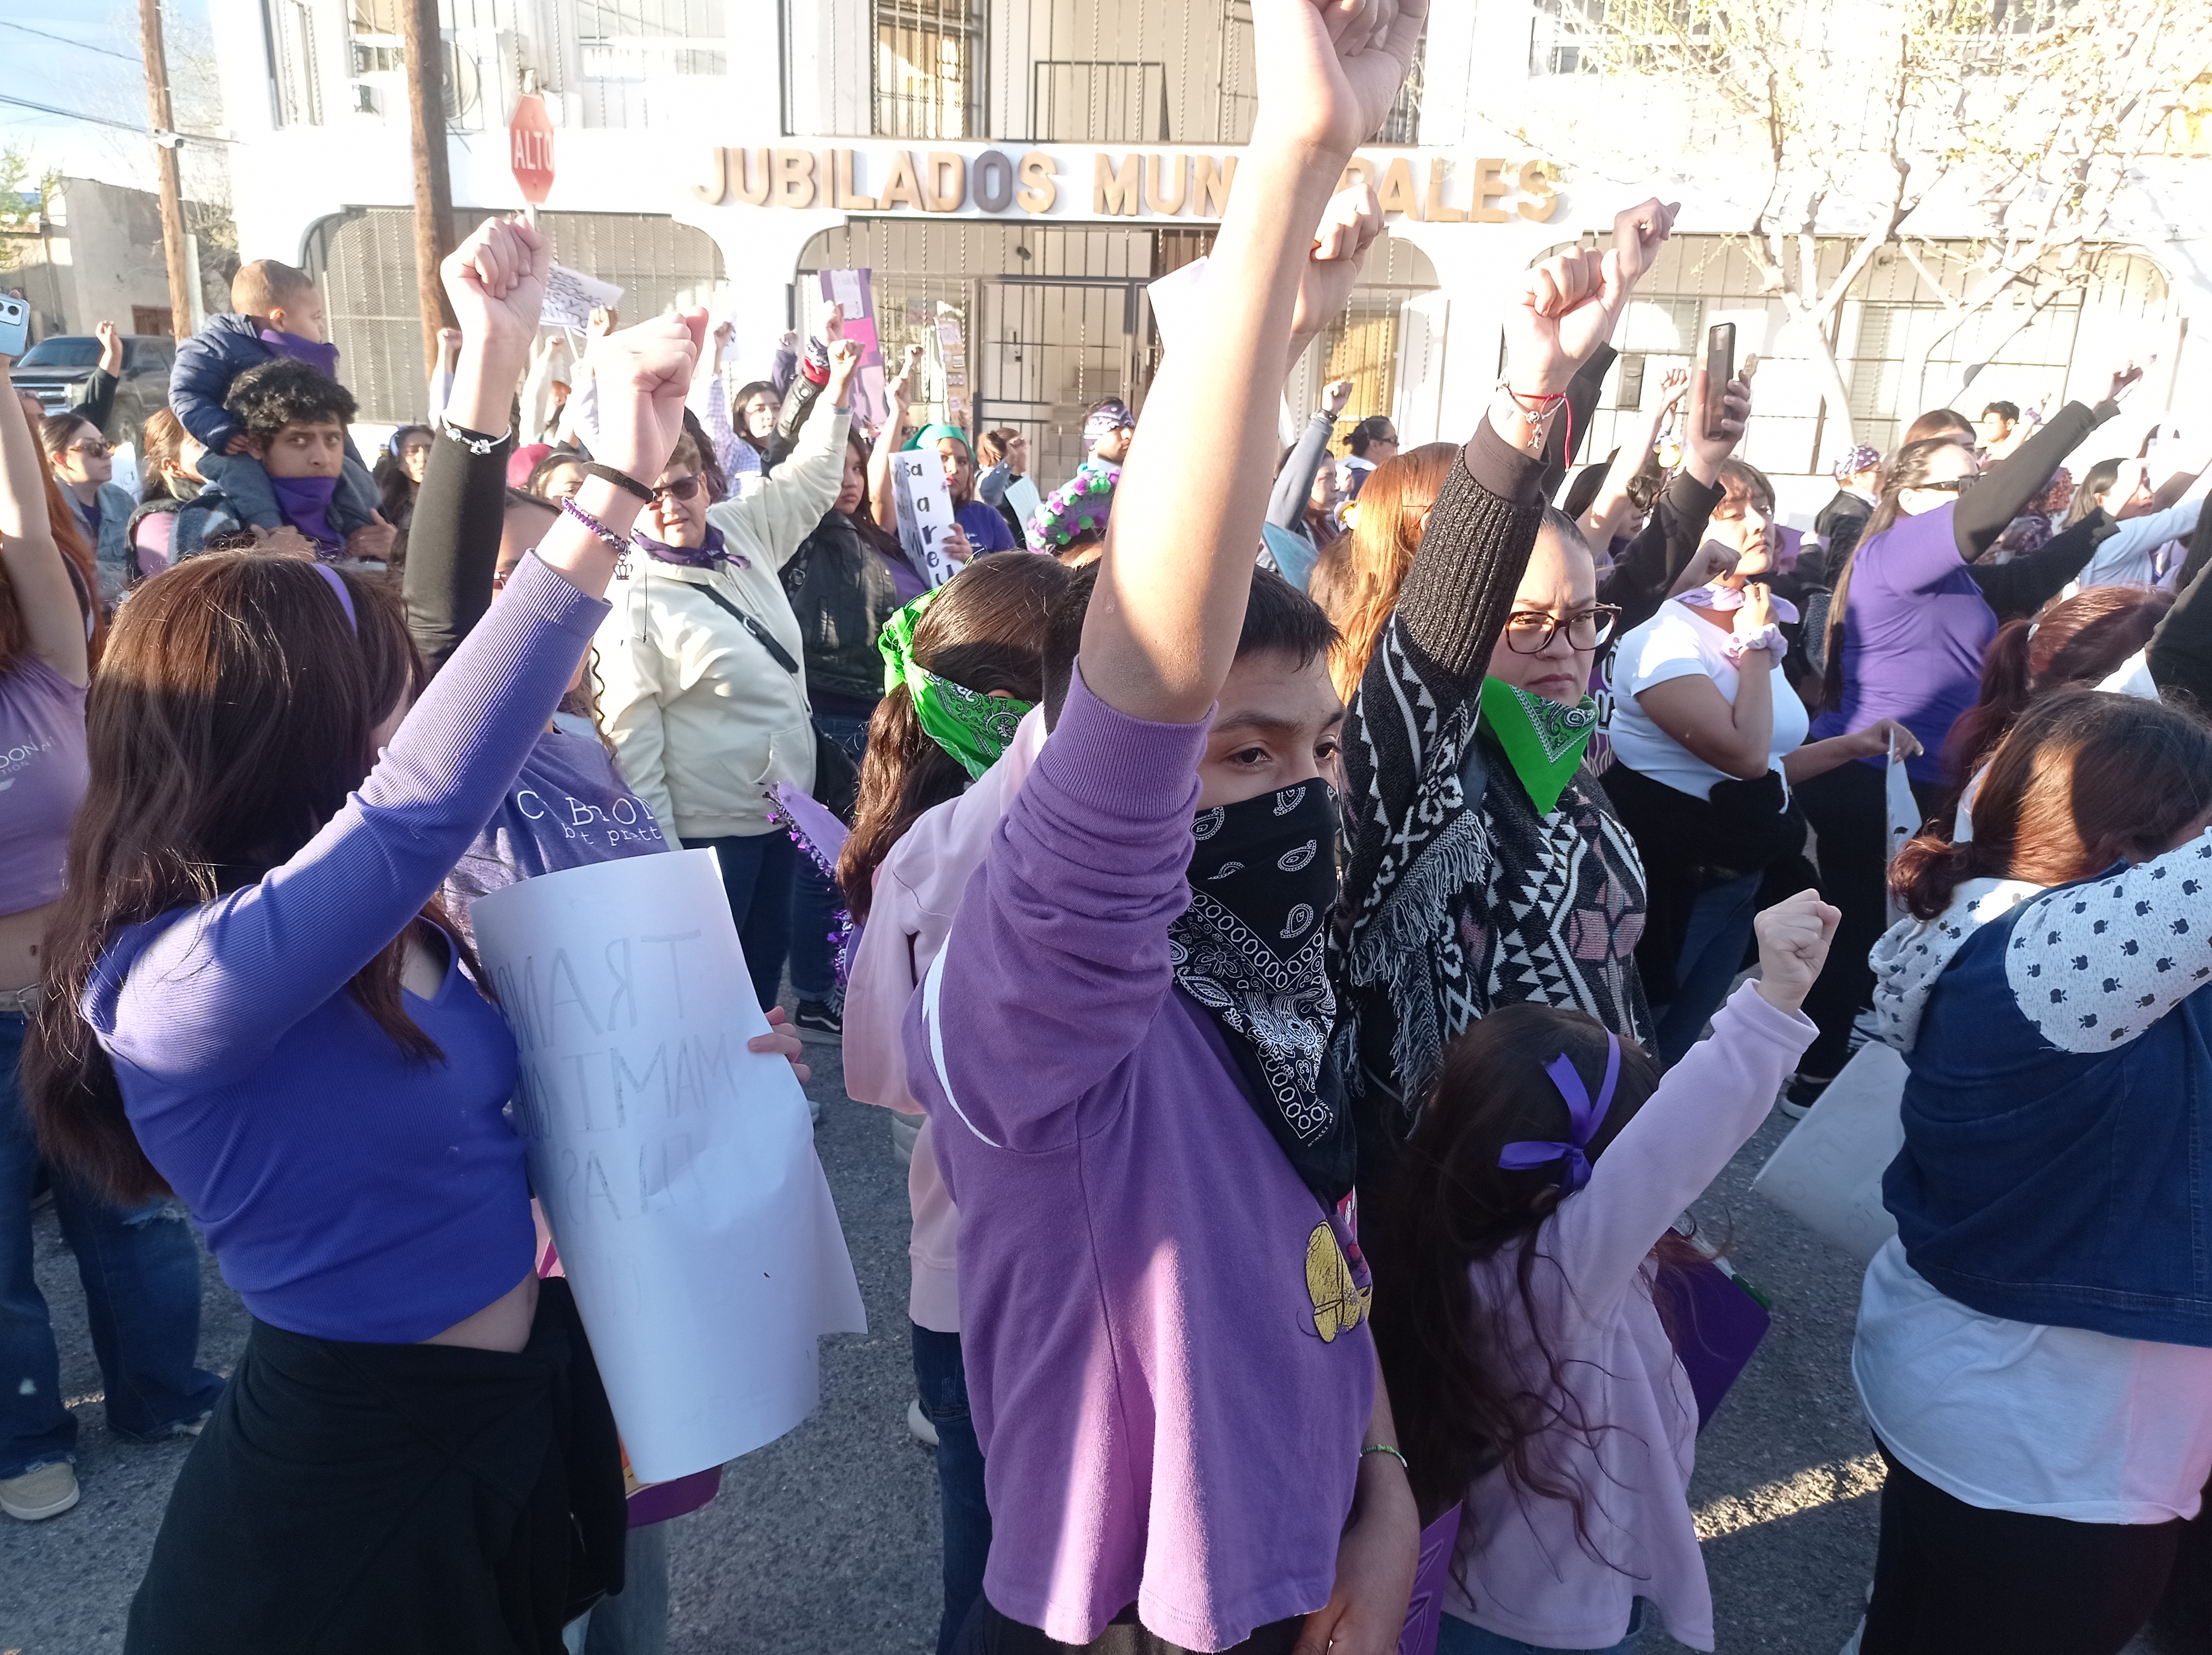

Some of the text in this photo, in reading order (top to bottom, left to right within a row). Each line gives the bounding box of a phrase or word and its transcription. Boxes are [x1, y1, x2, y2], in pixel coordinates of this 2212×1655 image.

[514, 129, 554, 172] ALTO
[690, 146, 1560, 223] JUBILADOS MUNPALES
